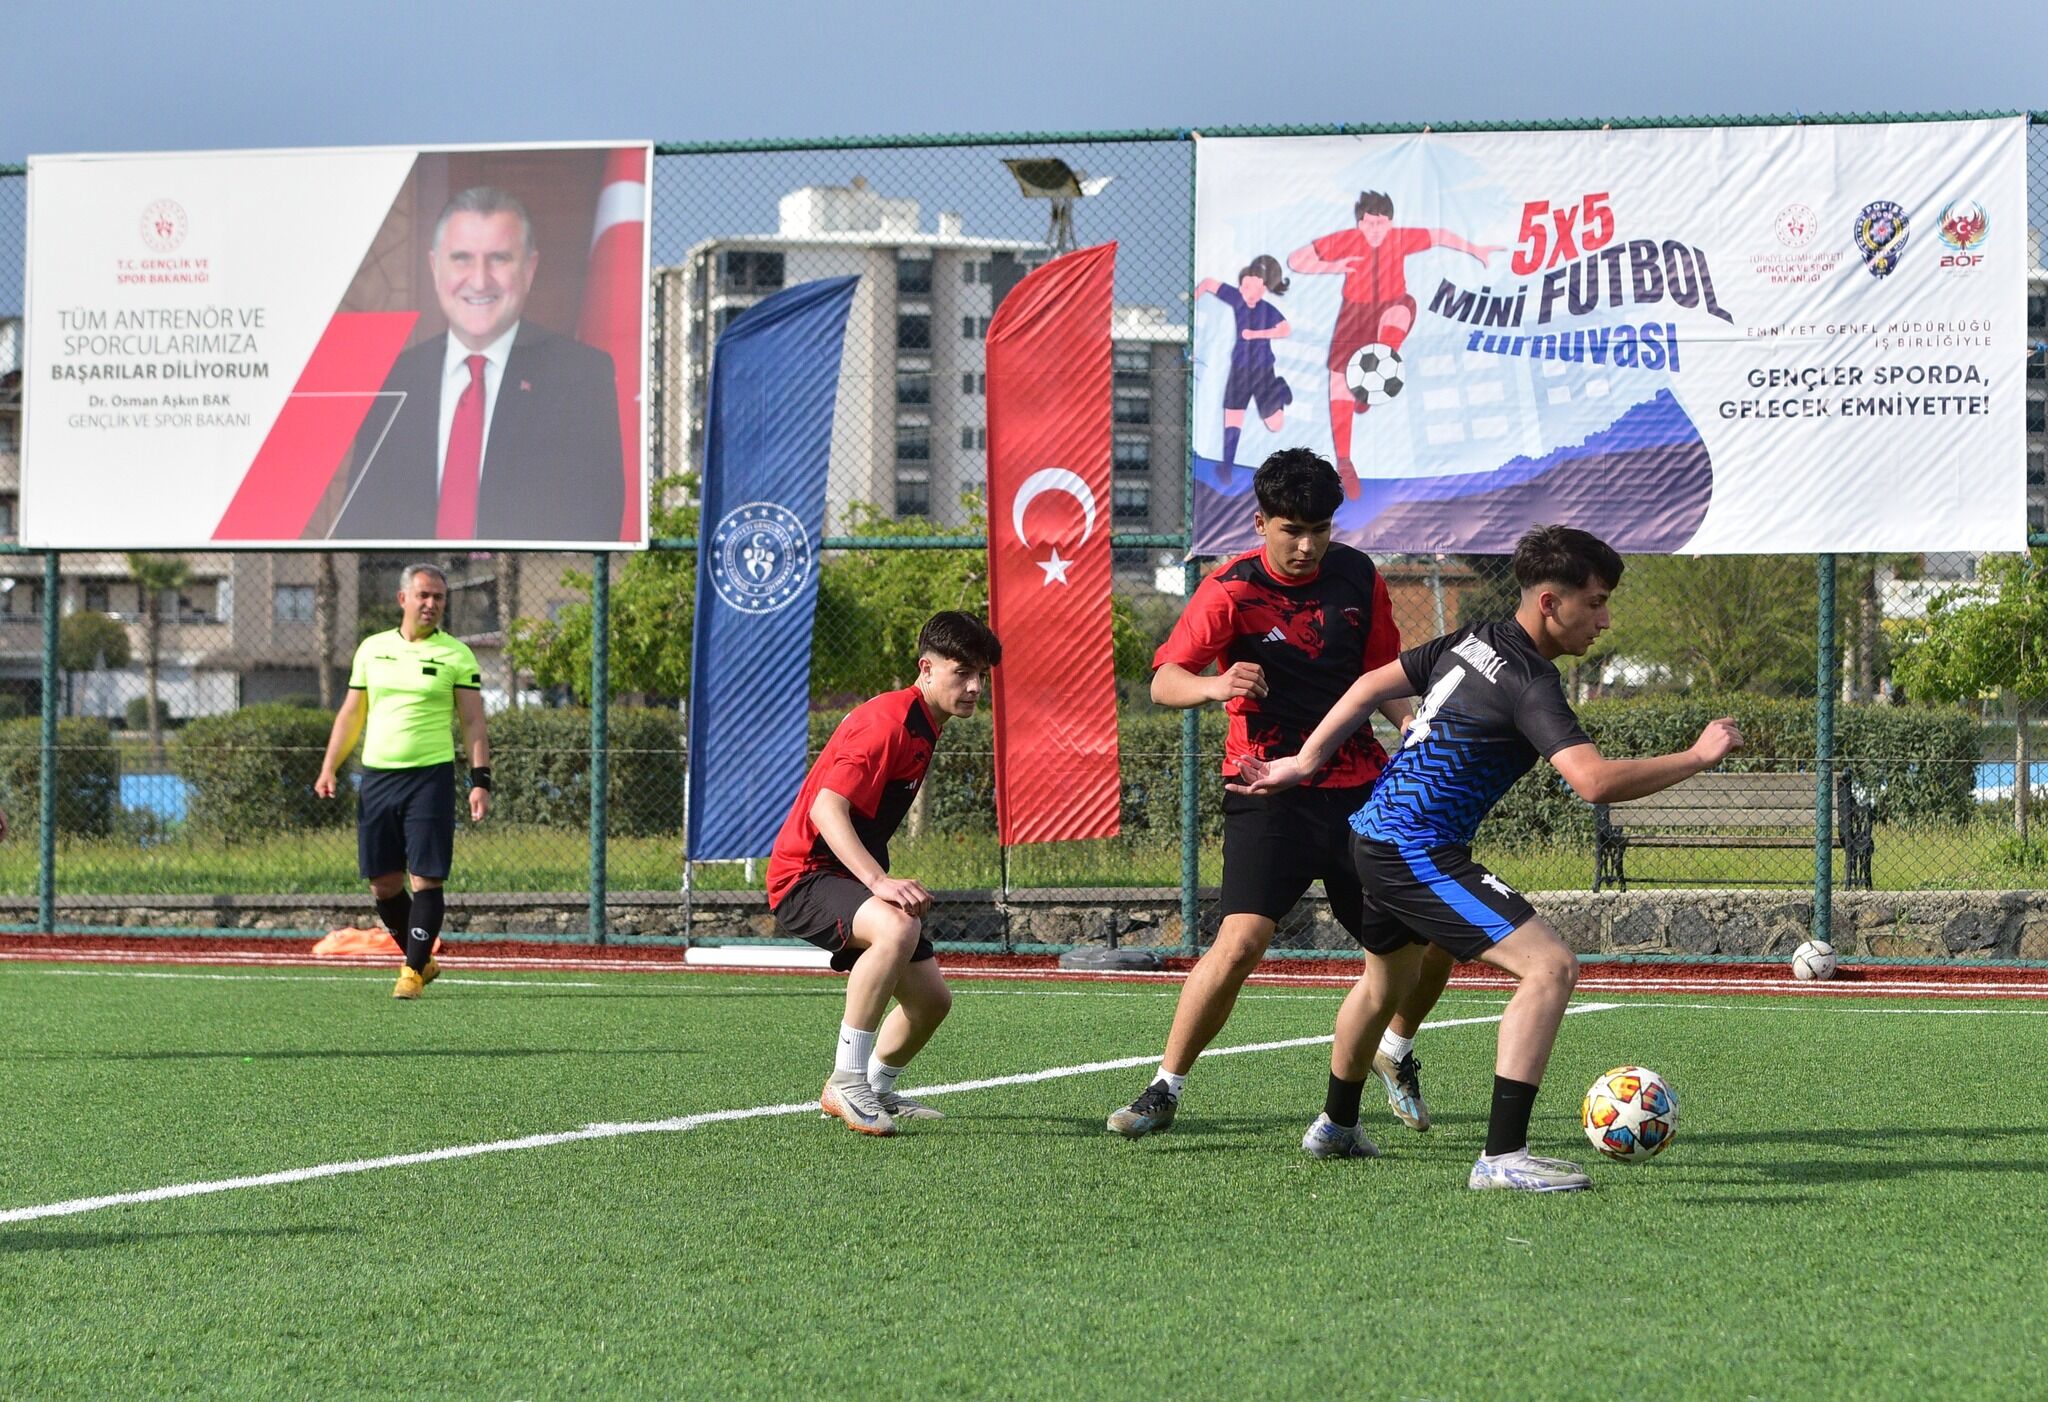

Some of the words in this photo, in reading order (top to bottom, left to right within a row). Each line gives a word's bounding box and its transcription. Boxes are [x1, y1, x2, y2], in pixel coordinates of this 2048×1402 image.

[1511, 192, 1615, 276] 5x5
[141, 258, 191, 271] GENÇLİK
[195, 259, 209, 269] VE
[1940, 251, 1985, 267] BÖF
[117, 274, 146, 284] SPOR
[150, 271, 209, 284] BAKANLIĞI
[1537, 239, 1735, 326] FUTBOL
[58, 307, 107, 331] TÜM
[114, 305, 233, 330] ANTRENÖR
[238, 308, 265, 328] VE
[1747, 325, 1817, 337] EMNİYET
[1888, 319, 1992, 334] MÜDÜRLÜĞÜ
[64, 333, 258, 356] SPORCULARIMIZA
[1875, 336, 1889, 350] İŞ
[1897, 334, 1992, 348] BİRLİĞİYLE
[51, 364, 157, 385] BAŞARILAR
[162, 359, 269, 380] DİLİYORUM
[1747, 366, 1863, 391] GENÇLER
[1873, 364, 1990, 387] SPORDA,
[89, 395, 108, 407] Dr.
[111, 395, 158, 407] Osman
[162, 394, 199, 409] Aşkın
[202, 394, 231, 406] BAK
[1719, 397, 1832, 419] GELECEK
[1841, 391, 1990, 417] EMNİYETTE!
[68, 413, 129, 430] GENÇLİK
[133, 414, 150, 428] VE
[154, 413, 192, 428] SPOR
[196, 412, 250, 427] BAKANI
